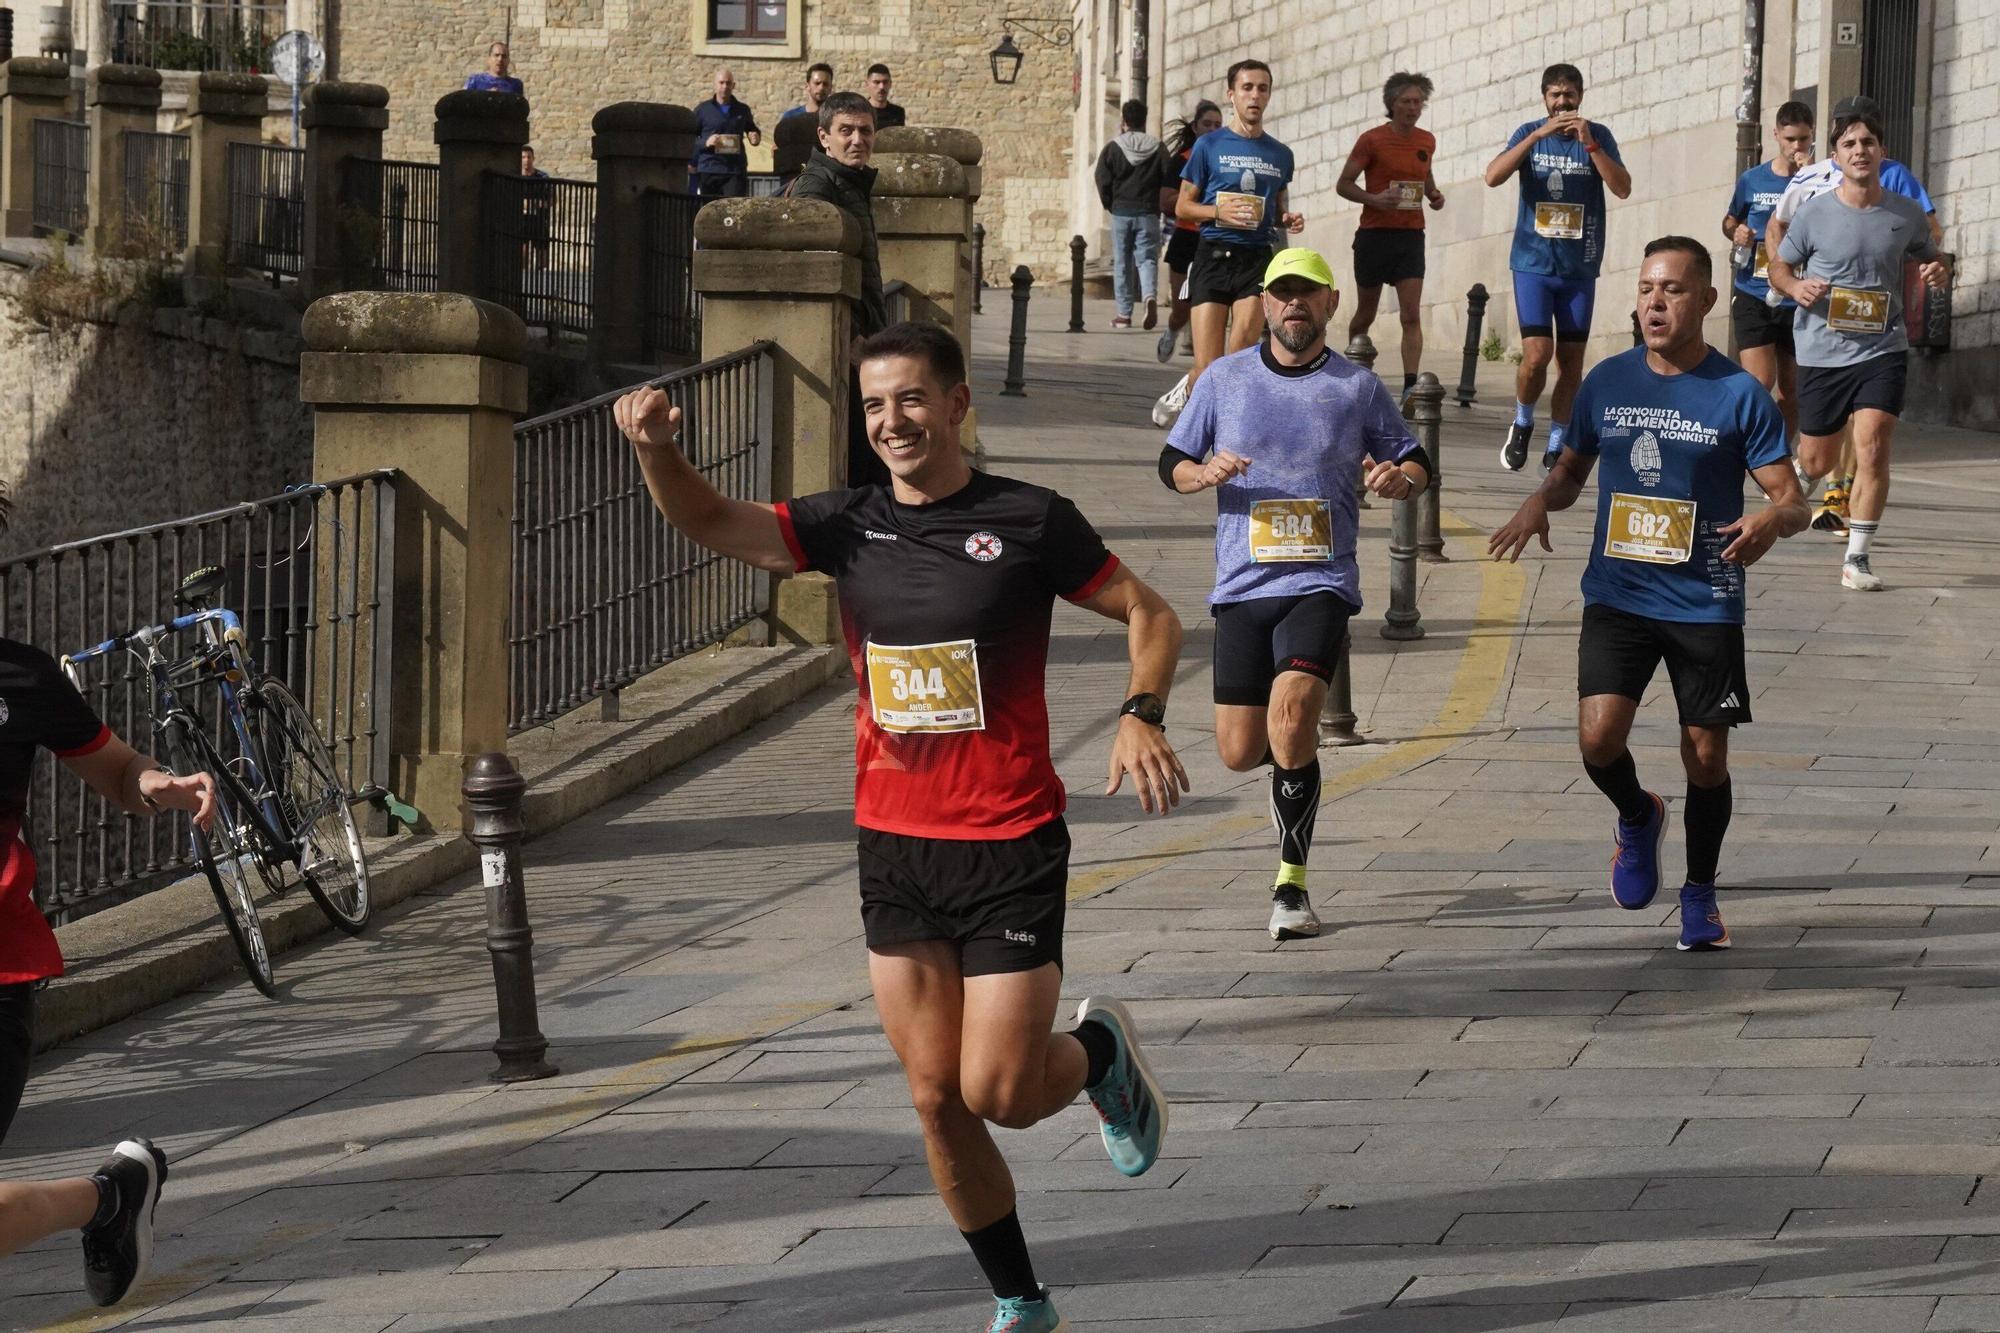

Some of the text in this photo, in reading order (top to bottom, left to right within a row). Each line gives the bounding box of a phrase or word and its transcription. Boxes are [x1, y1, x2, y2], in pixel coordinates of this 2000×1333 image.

[1230, 161, 1274, 170] ALMENDRA
[1549, 211, 1570, 225] 221
[1846, 299, 1873, 317] 213
[1604, 406, 1680, 420] LA CONQUISTA
[1616, 415, 1703, 434] ALMENDRA
[1660, 430, 1718, 446] KONKISTA
[1271, 514, 1314, 538] 584
[1628, 511, 1671, 539] 682
[951, 648, 968, 660] 10K
[889, 667, 947, 701] 344
[908, 703, 933, 711] ANDER
[1004, 929, 1037, 947] kräg
